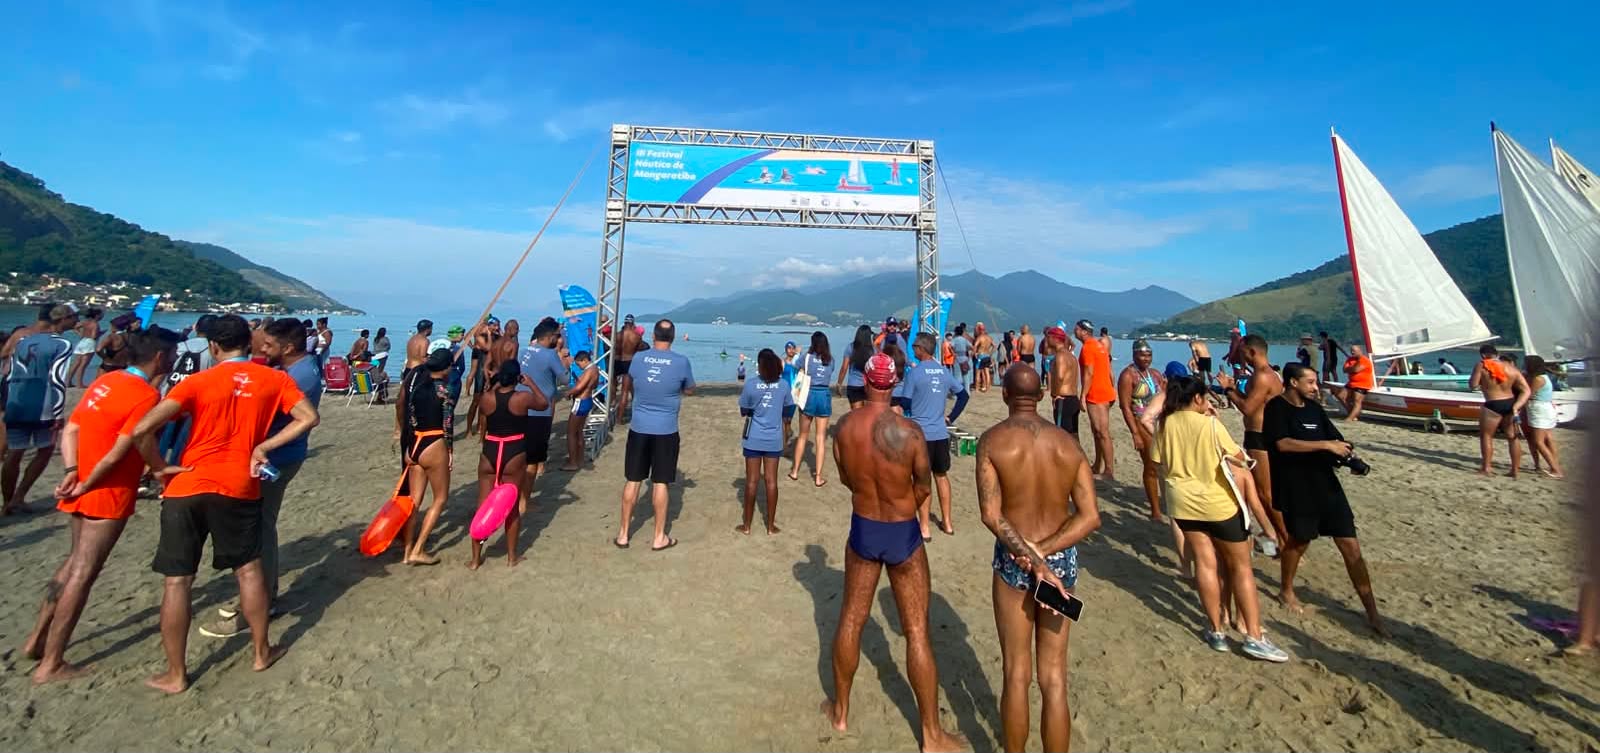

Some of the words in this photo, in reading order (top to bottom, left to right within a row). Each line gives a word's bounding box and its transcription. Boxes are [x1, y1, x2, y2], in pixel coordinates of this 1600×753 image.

[648, 149, 683, 158] Festival
[635, 159, 672, 168] Náutico
[673, 160, 684, 169] de
[633, 170, 696, 180] Mangaratiba
[644, 356, 672, 366] EQUIPE
